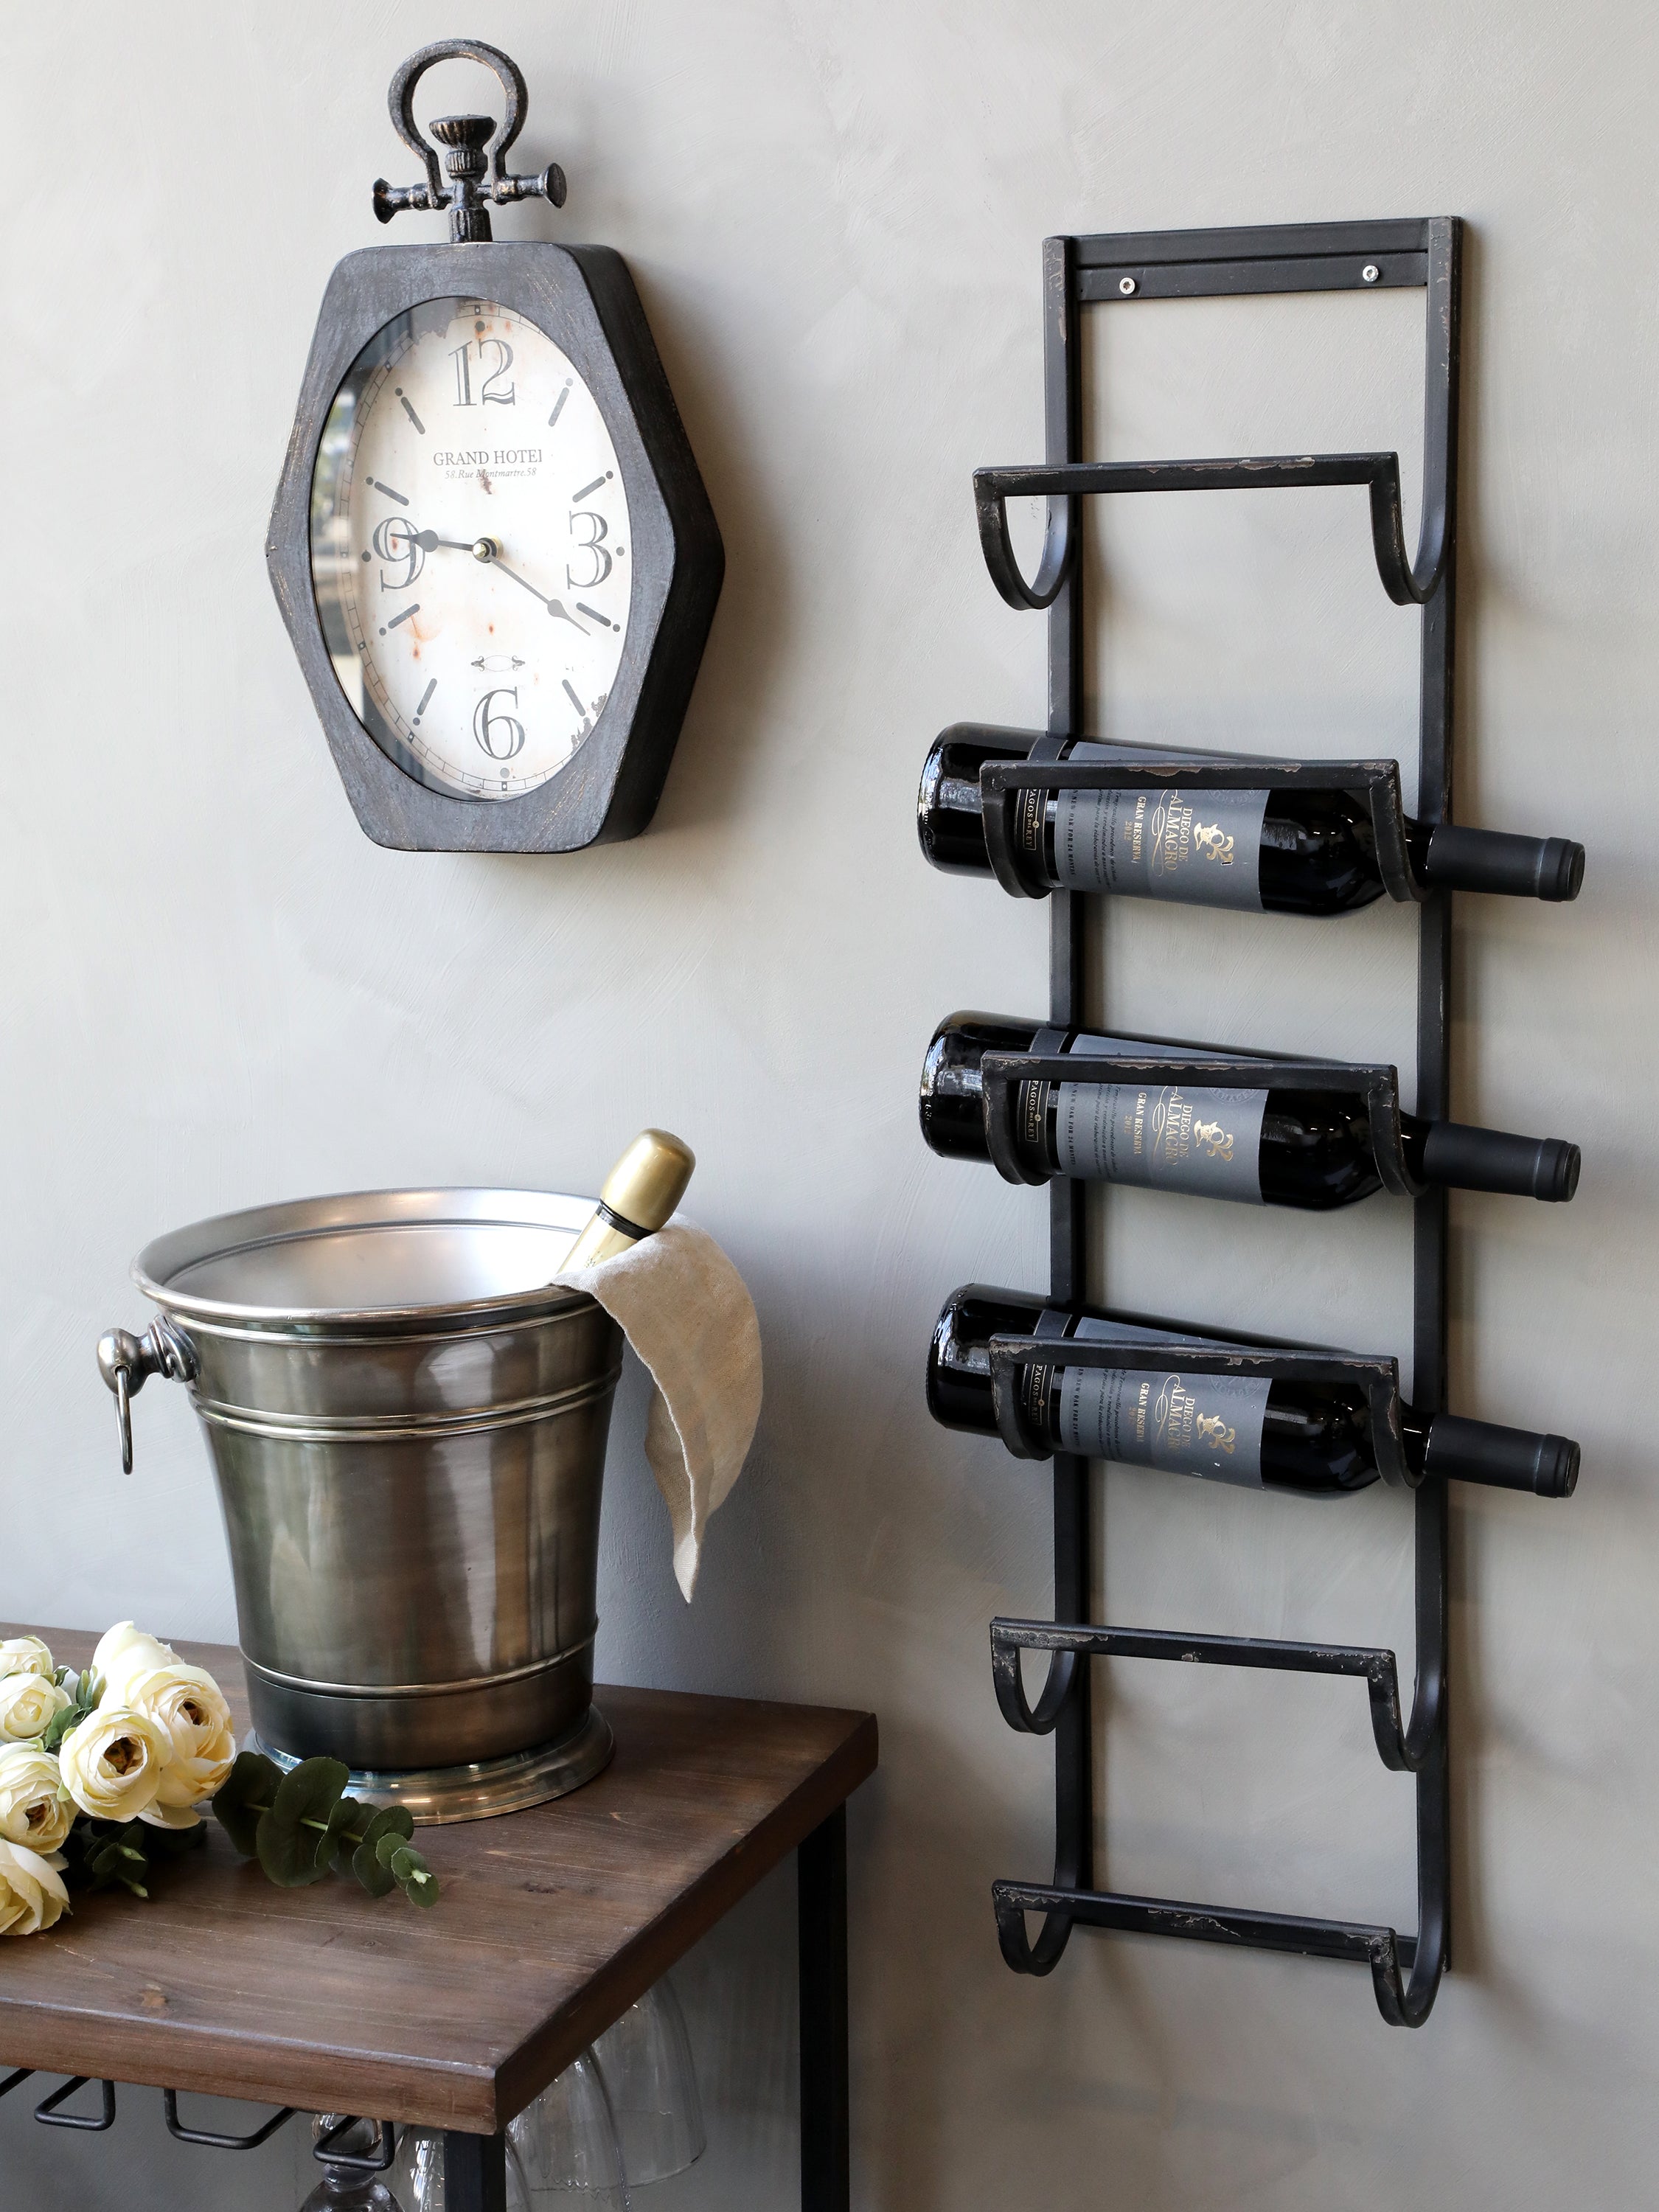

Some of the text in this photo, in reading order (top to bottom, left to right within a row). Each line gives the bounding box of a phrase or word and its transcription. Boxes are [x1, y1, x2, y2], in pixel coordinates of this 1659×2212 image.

[448, 338, 515, 406] 12
[434, 451, 489, 466] GRAND
[373, 517, 425, 592] 9
[566, 511, 612, 591] 3
[473, 686, 526, 761] 6
[1133, 796, 1147, 860] GRAN RESERVA
[1164, 795, 1183, 871] ALMAGRO
[1178, 808, 1192, 862] DIEGO DE
[1029, 1080, 1039, 1111] PAGOS
[1133, 1092, 1147, 1155] GRAN RESERVA
[1165, 1091, 1183, 1166] ALMAGRO
[1179, 1105, 1192, 1157] DIEGO DE
[1032, 1364, 1043, 1396] PAGOS
[1138, 1382, 1150, 1406] GRAN
[1182, 1397, 1195, 1432] DIEGO
